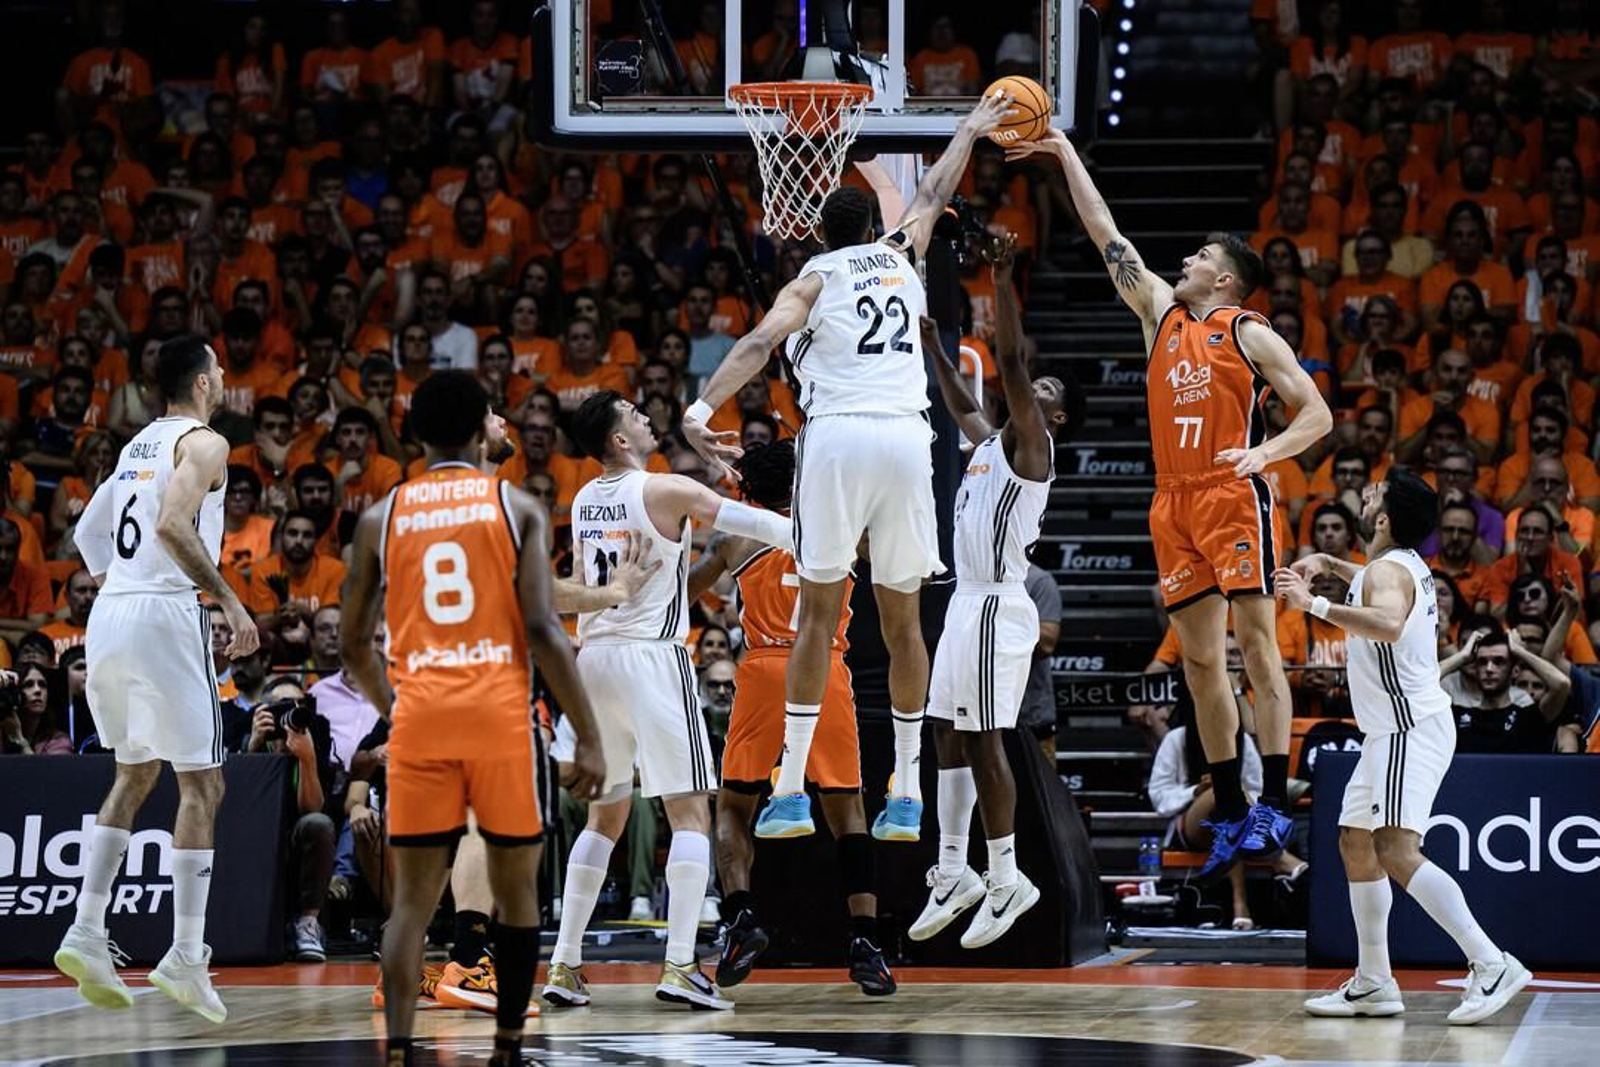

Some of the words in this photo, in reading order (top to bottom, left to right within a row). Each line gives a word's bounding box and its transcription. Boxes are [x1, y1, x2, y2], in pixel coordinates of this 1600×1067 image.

[847, 253, 898, 275] TAVARES
[856, 295, 913, 354] 22
[1100, 361, 1146, 383] Torr
[1173, 386, 1211, 407] ARENA
[1174, 417, 1203, 449] 77
[1076, 449, 1145, 474] Torres
[405, 478, 488, 505] MONTERO
[117, 493, 142, 559] 6
[1059, 544, 1132, 569] Torres
[423, 541, 475, 625] 8
[0, 884, 173, 915] ESPRT
